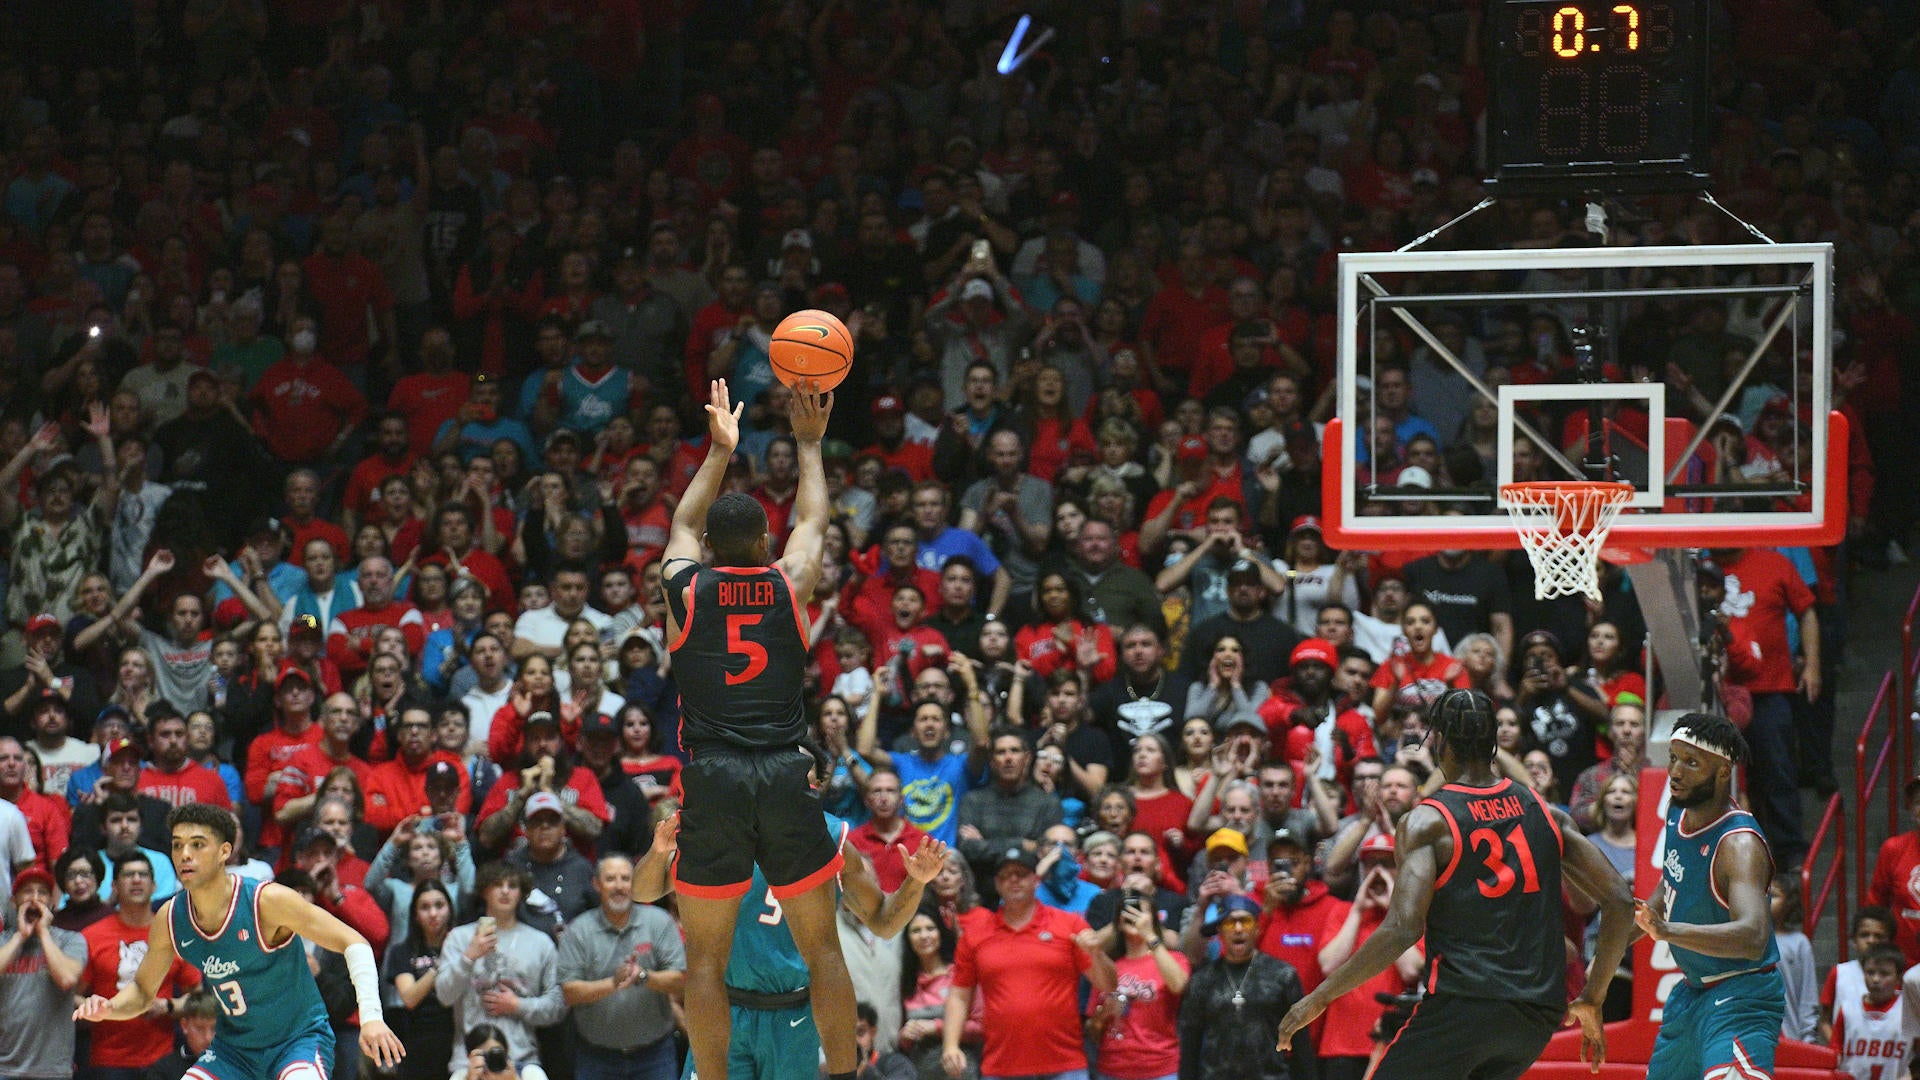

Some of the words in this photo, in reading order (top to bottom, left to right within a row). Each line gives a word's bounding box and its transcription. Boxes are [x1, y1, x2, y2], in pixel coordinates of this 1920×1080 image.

[1552, 6, 1639, 57] 0.7
[718, 581, 775, 607] BUTLER
[725, 613, 769, 686] 5
[1466, 795, 1525, 823] MENSAH
[1469, 823, 1541, 899] 31
[1846, 1038, 1907, 1060] LOBOS
